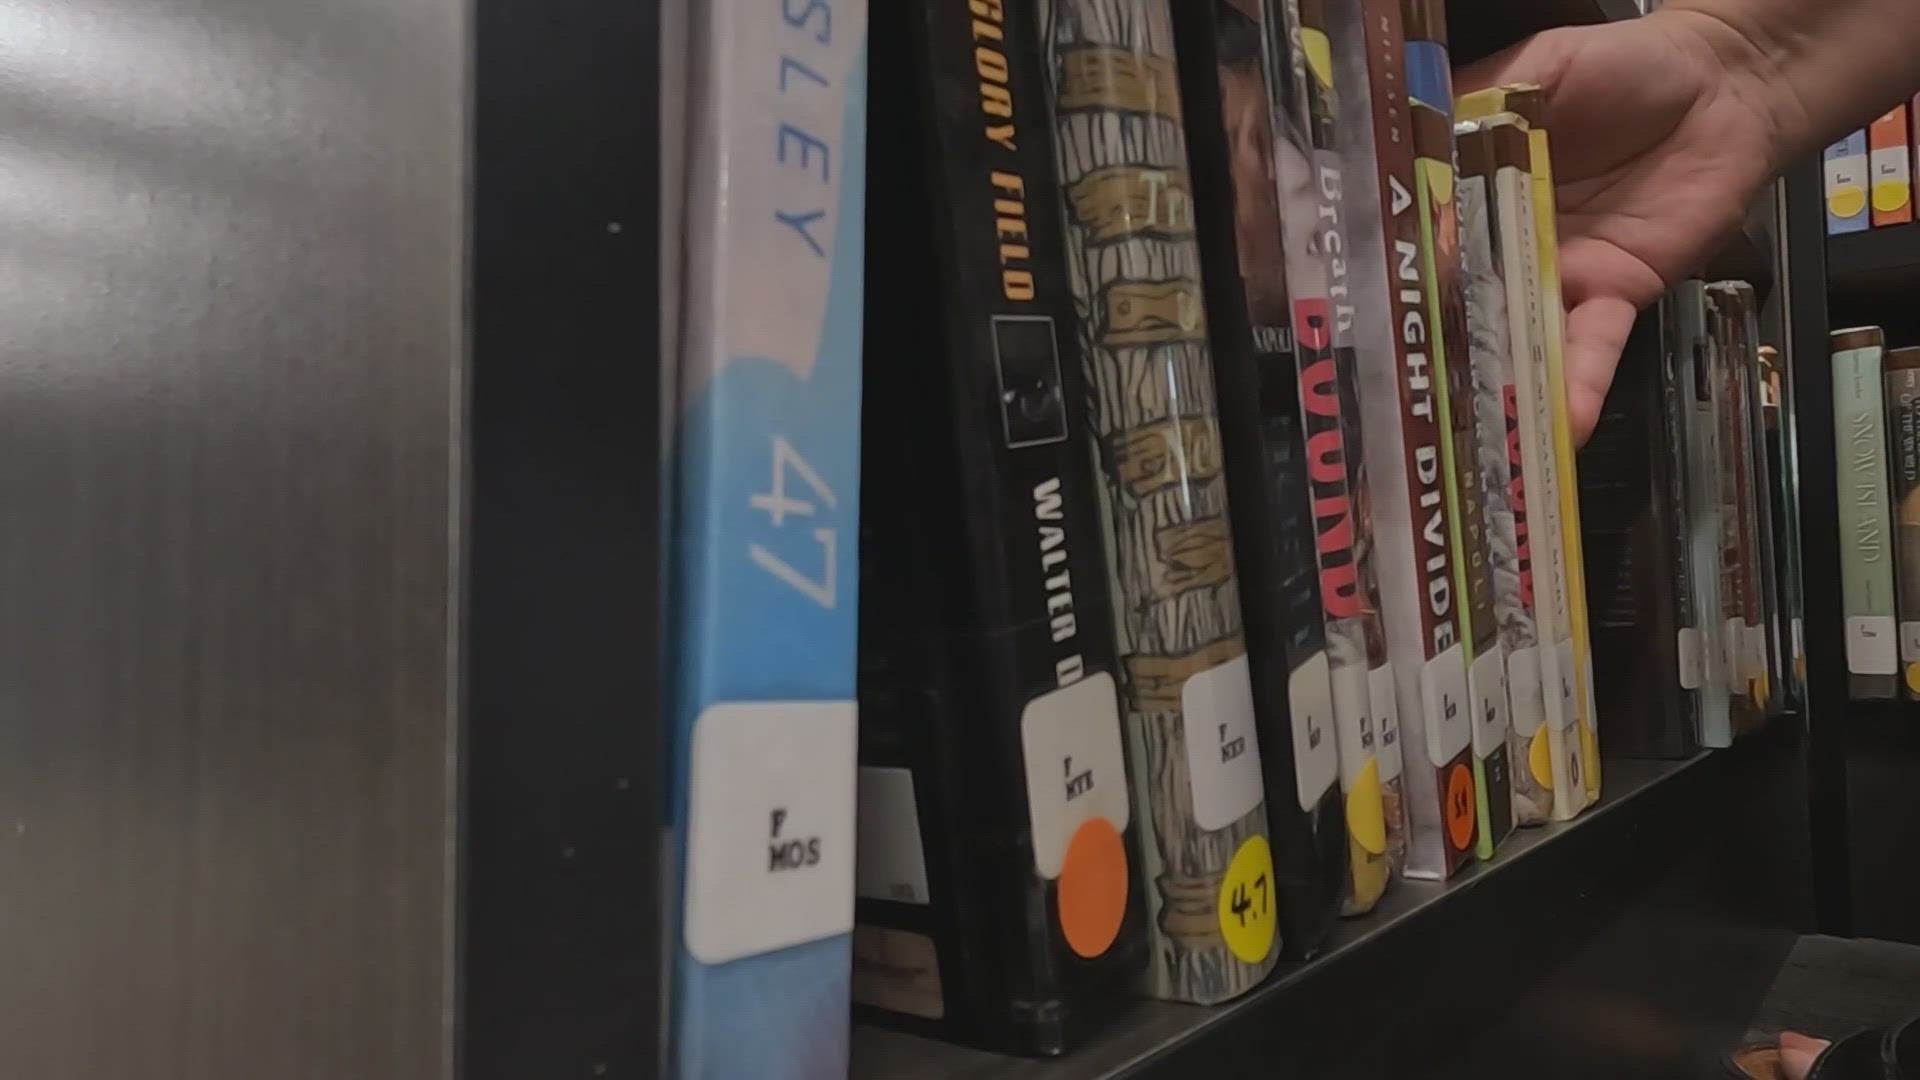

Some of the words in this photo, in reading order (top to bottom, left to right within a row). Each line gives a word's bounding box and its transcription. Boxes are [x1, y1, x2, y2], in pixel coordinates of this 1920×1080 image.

[774, 0, 832, 257] SLEY
[969, 0, 1017, 151] GLORY
[1380, 15, 1400, 143] NIELSEN
[991, 171, 1035, 300] FIELD
[1318, 166, 1355, 332] Breath
[1388, 174, 1412, 216] A
[1394, 240, 1433, 423] NIGHT
[1852, 412, 1876, 475] SNOW
[749, 436, 838, 610] 47
[1033, 477, 1077, 642] WALTER
[1415, 445, 1456, 654] DIVIDE
[1463, 471, 1484, 609] NAPOLI
[1855, 484, 1881, 562] ISLAND
[770, 808, 787, 838] F
[1063, 755, 1073, 779] F
[1066, 769, 1095, 801] MYE
[767, 837, 821, 872] MOS
[1231, 874, 1269, 928] 4.7
